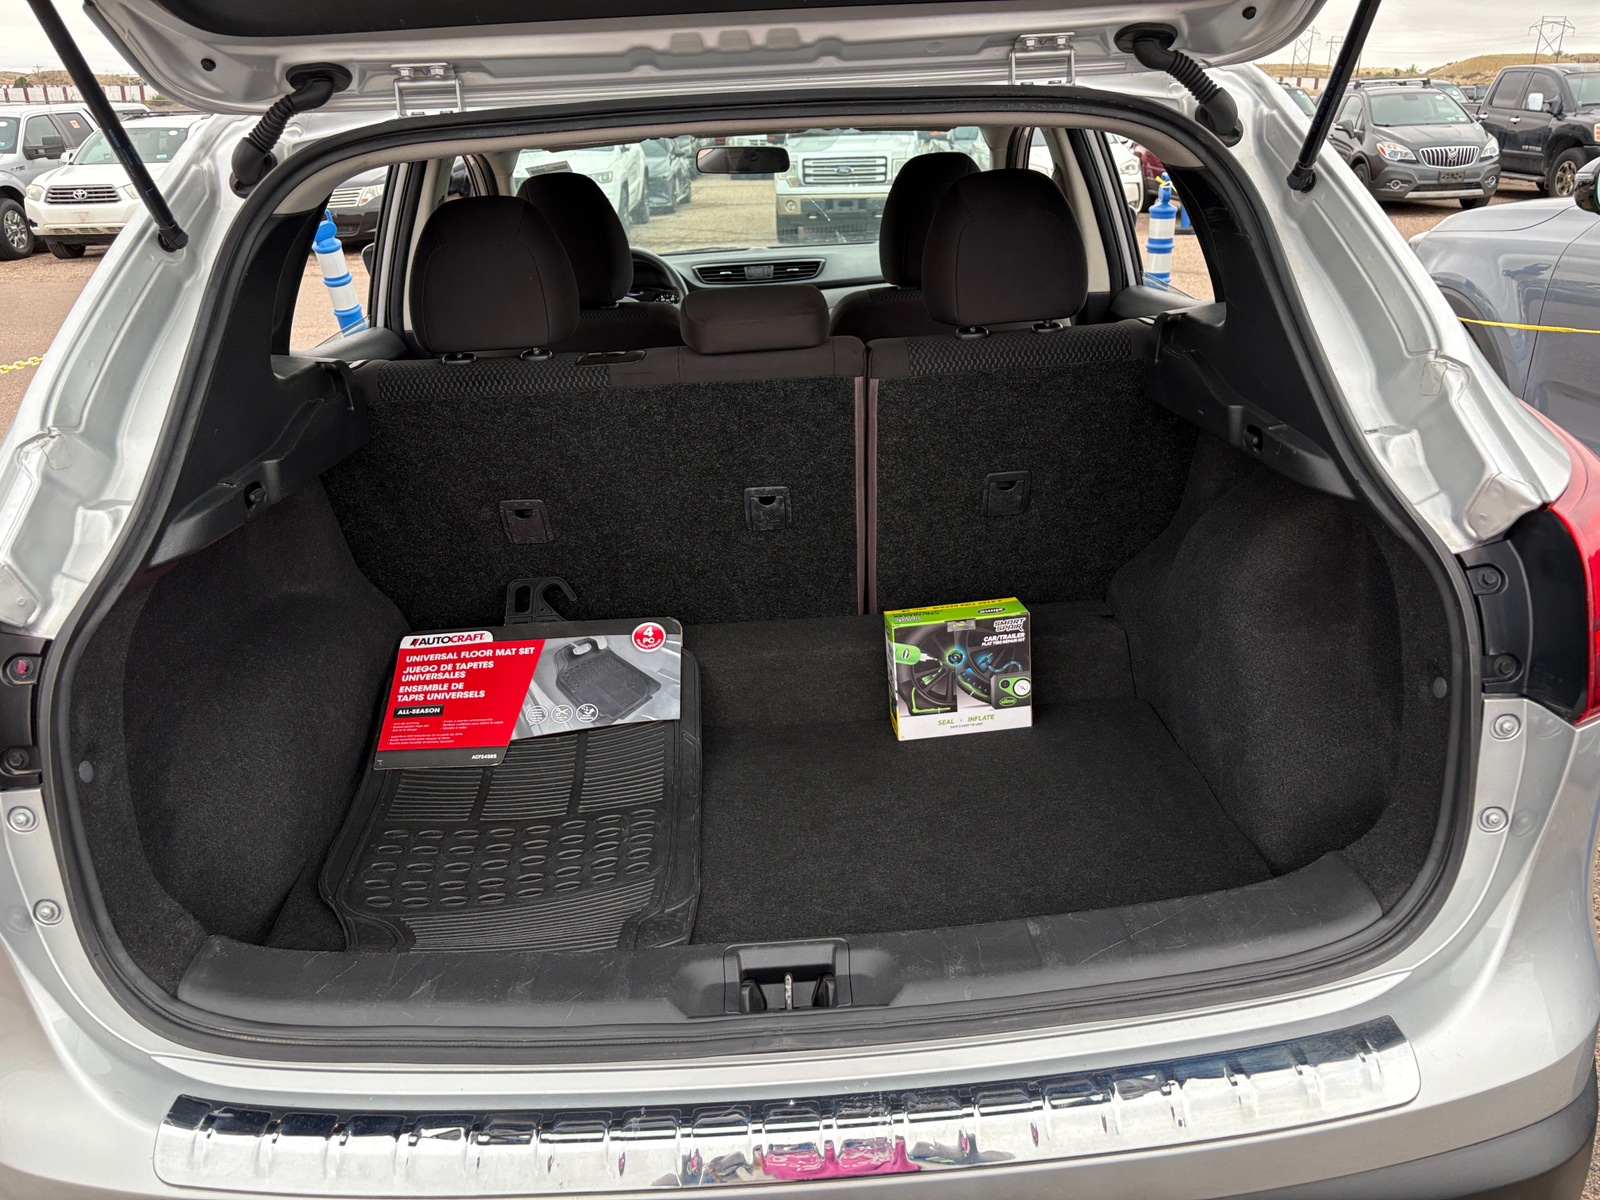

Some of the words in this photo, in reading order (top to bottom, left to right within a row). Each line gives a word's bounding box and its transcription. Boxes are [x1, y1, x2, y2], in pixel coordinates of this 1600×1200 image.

[993, 617, 1026, 627] SMART
[643, 626, 654, 637] 4
[983, 632, 1026, 642] CAR/TRAILER
[418, 633, 485, 646] AUTOCRAFT
[405, 652, 458, 663] UNIVERSAL
[460, 649, 493, 659] FLOOR
[495, 647, 517, 657] MAT
[518, 647, 535, 655] SET
[403, 664, 438, 674] JUEGO
[440, 663, 453, 671] DE
[455, 661, 495, 670] TAPETES
[401, 671, 466, 682] UNIVERSALES
[398, 683, 449, 694] ENSEMBLE
[451, 682, 465, 690] DE
[397, 693, 425, 702] TAPIS
[426, 690, 486, 701] UNIVERSELS
[397, 707, 441, 715] ALL-SEASON
[967, 714, 995, 722] INFLATE
